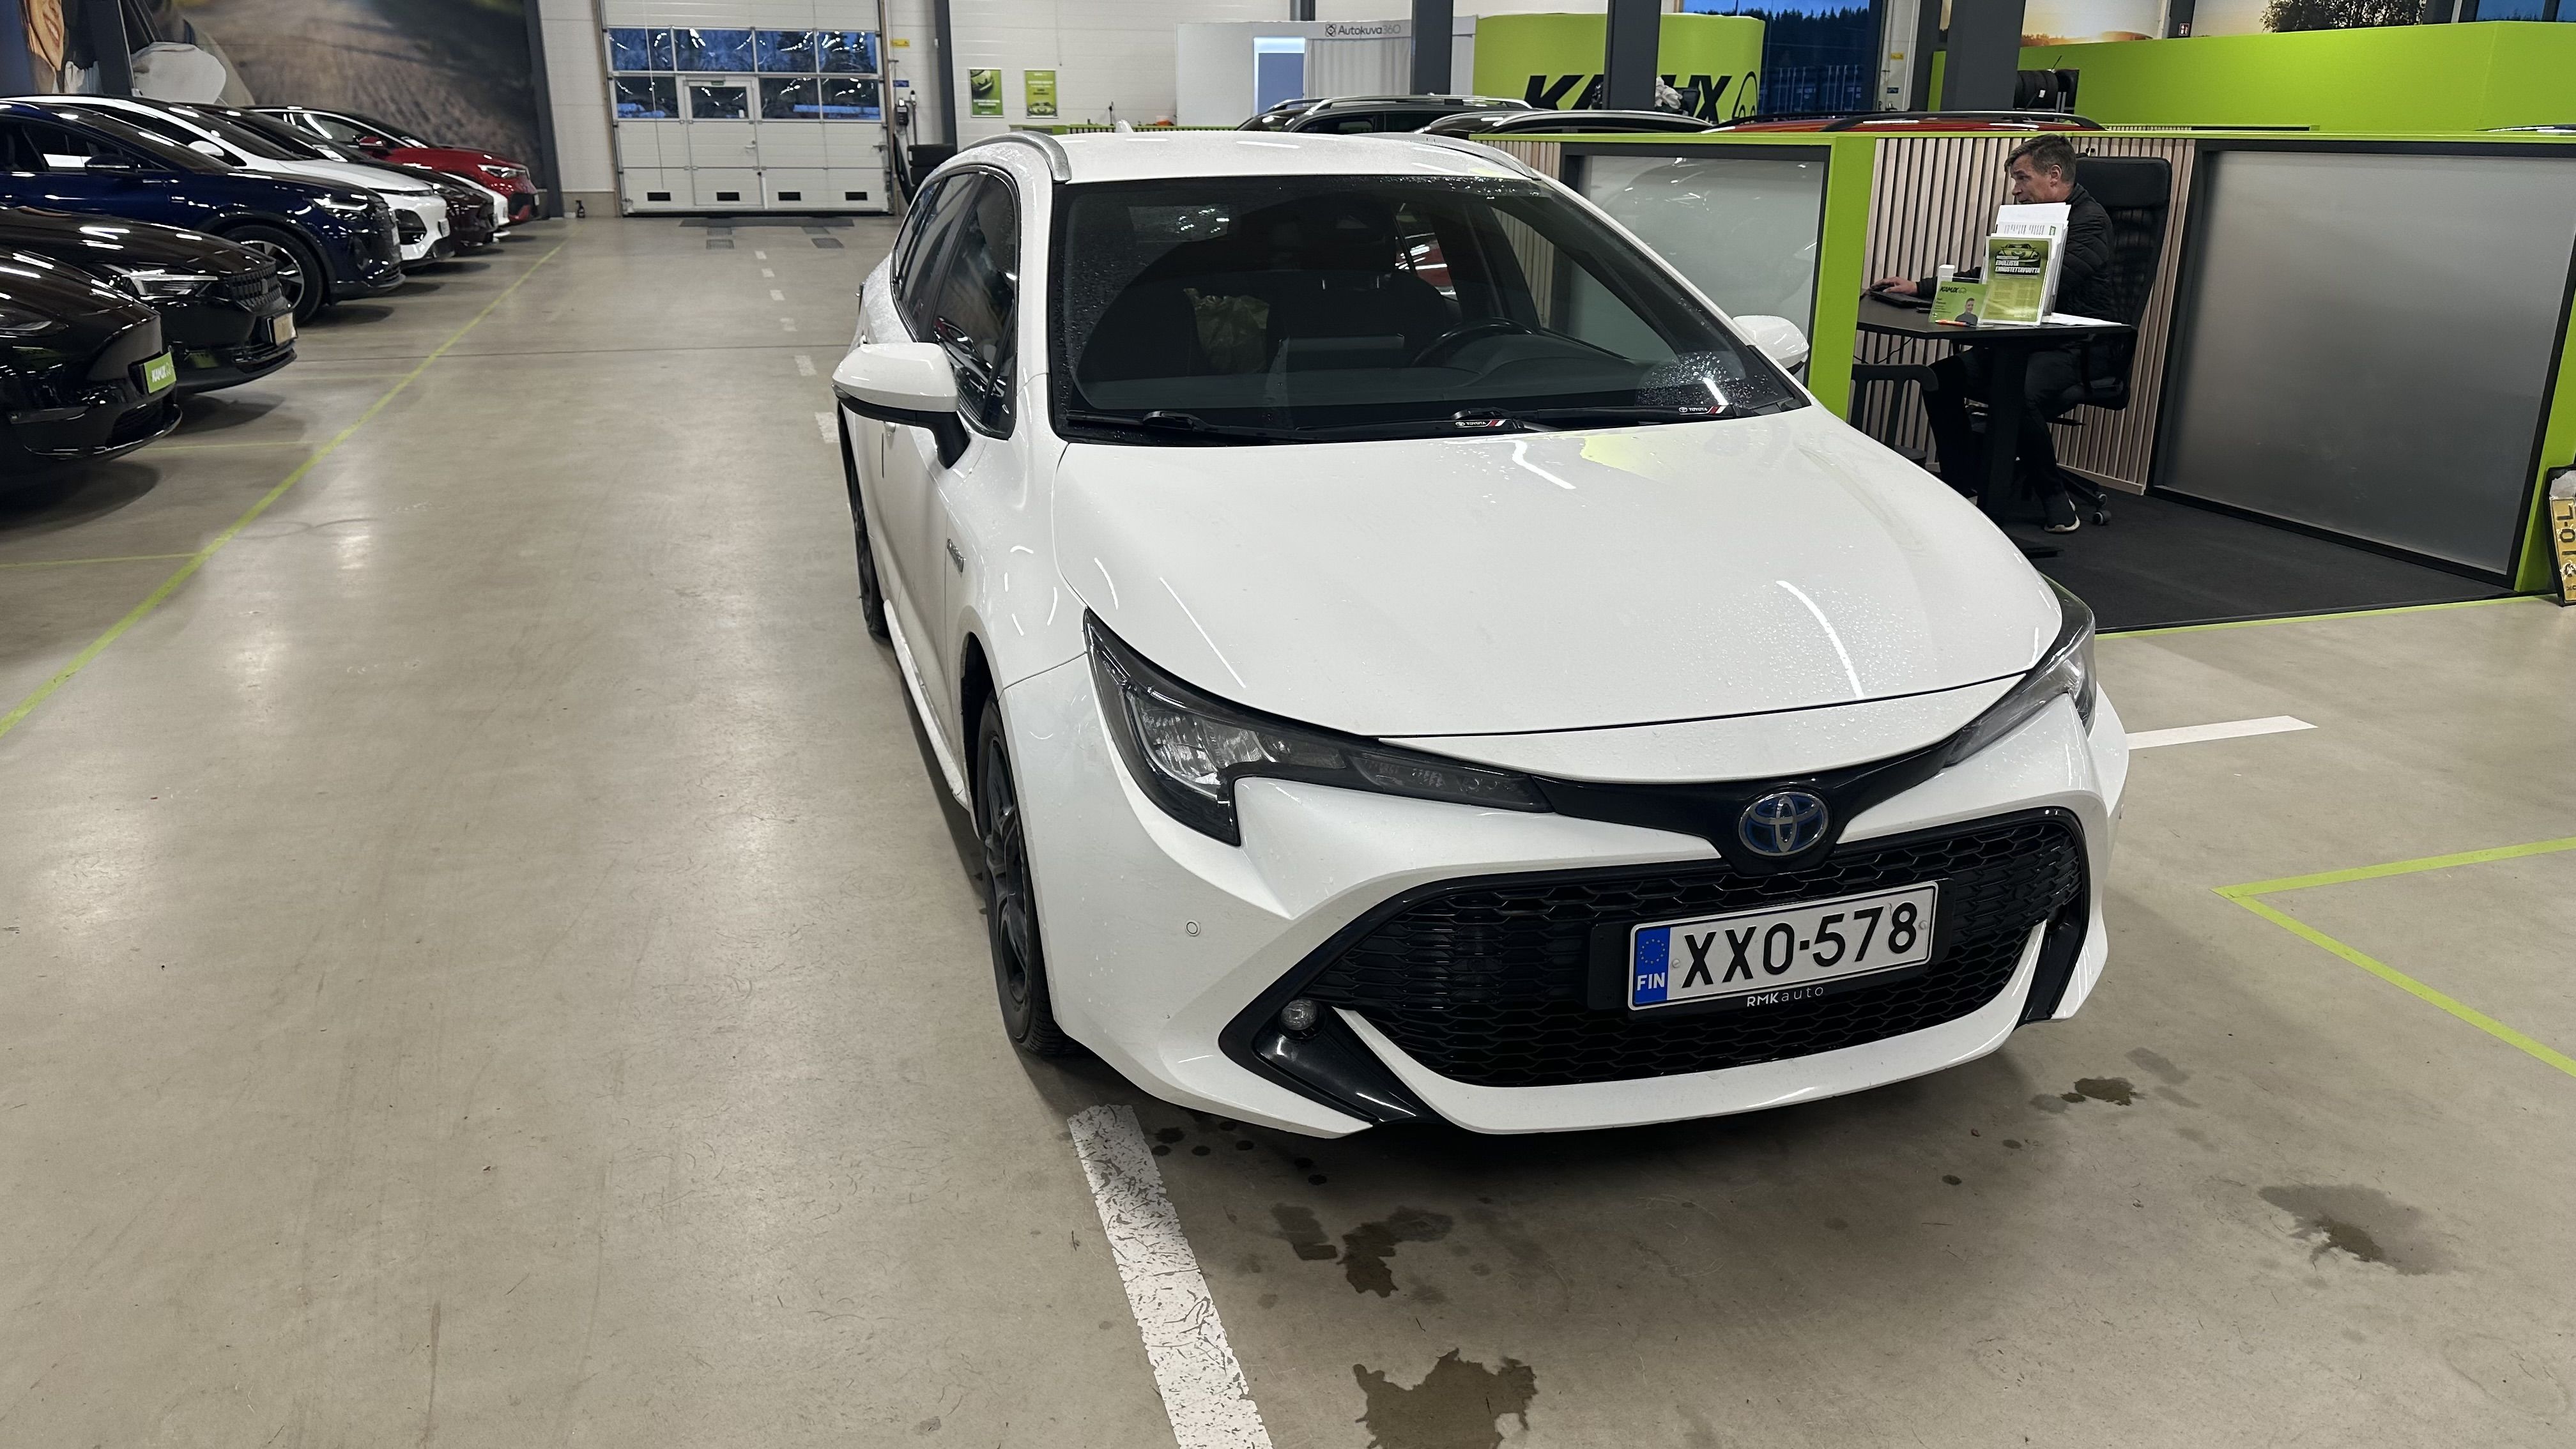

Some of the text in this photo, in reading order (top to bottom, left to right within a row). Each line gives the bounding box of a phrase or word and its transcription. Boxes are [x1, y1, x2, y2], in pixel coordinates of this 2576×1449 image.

[1338, 24, 1401, 35] Autokuva360
[1523, 74, 1733, 125] KAX
[1682, 902, 1917, 988] XXO-578
[1636, 972, 1666, 991] FIN
[1746, 986, 1824, 1007] RMKauto
